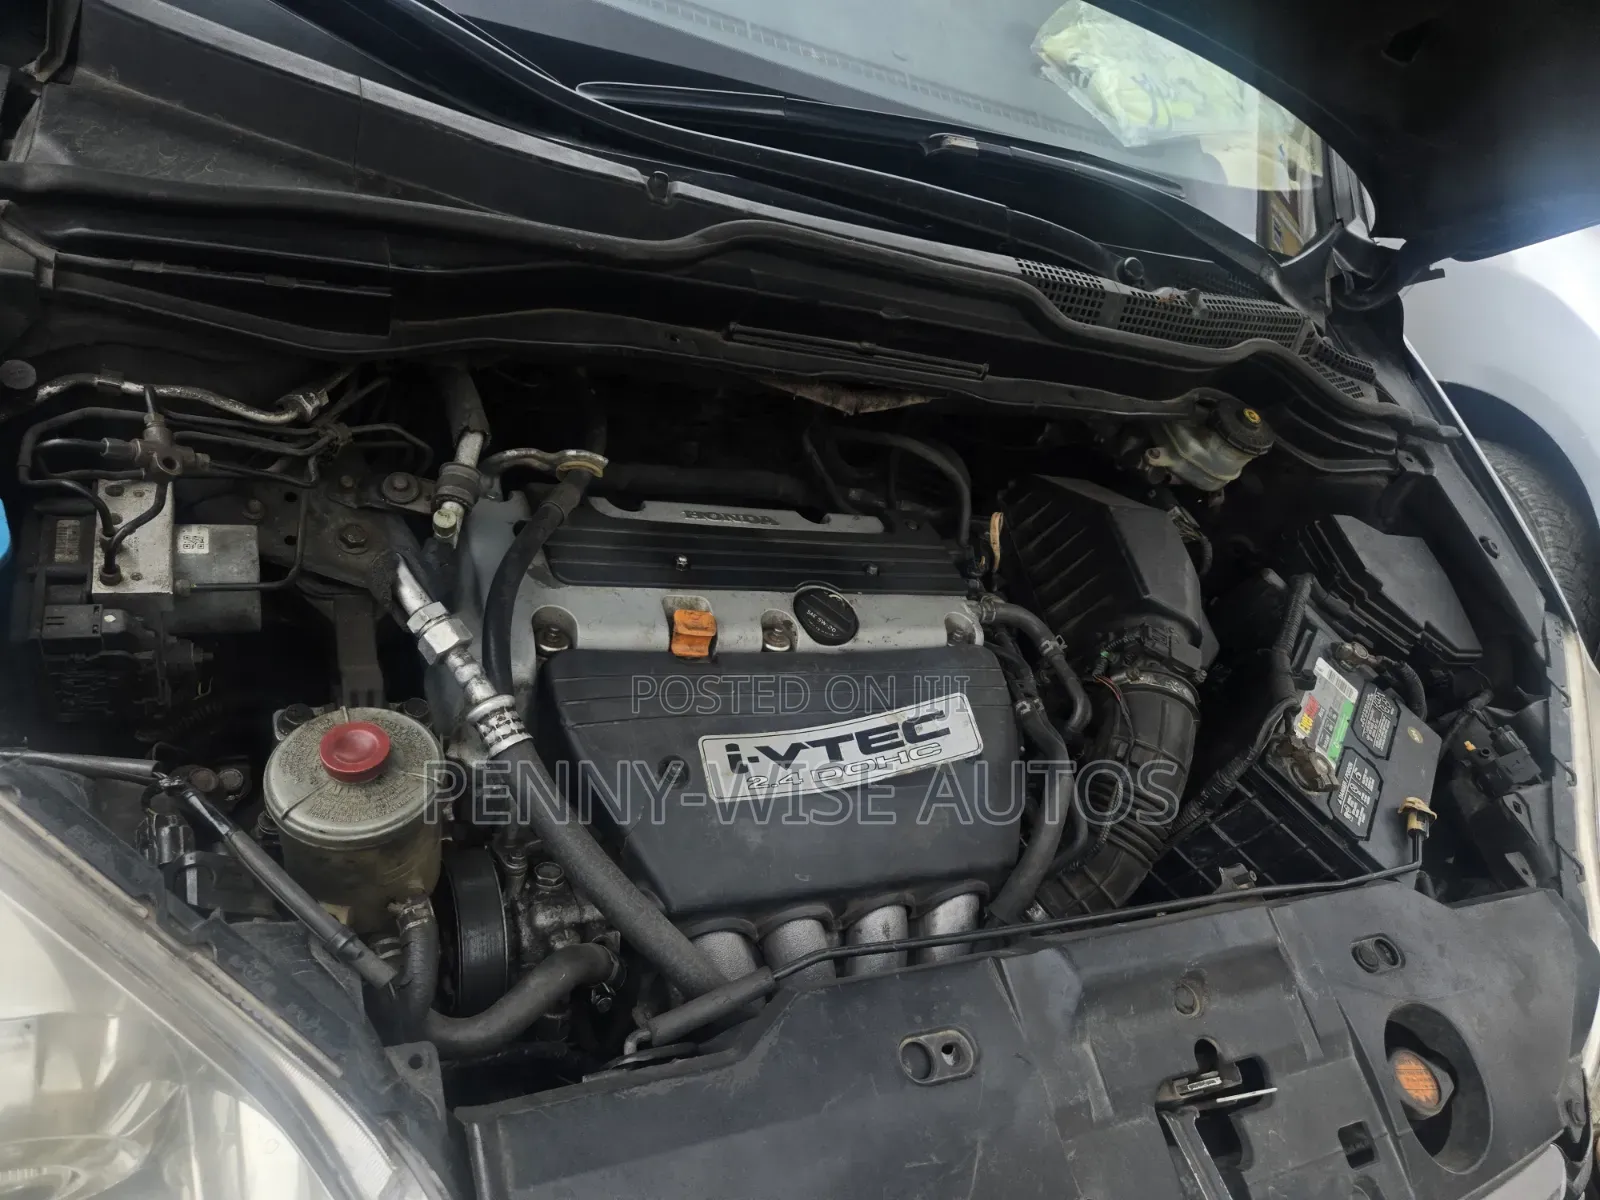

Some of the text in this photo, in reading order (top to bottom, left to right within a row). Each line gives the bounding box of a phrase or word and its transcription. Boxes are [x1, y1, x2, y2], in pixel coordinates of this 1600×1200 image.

[682, 509, 780, 526] HONDA
[724, 709, 951, 775] i-VTEC
[746, 741, 943, 791] 2.4 DOHC
